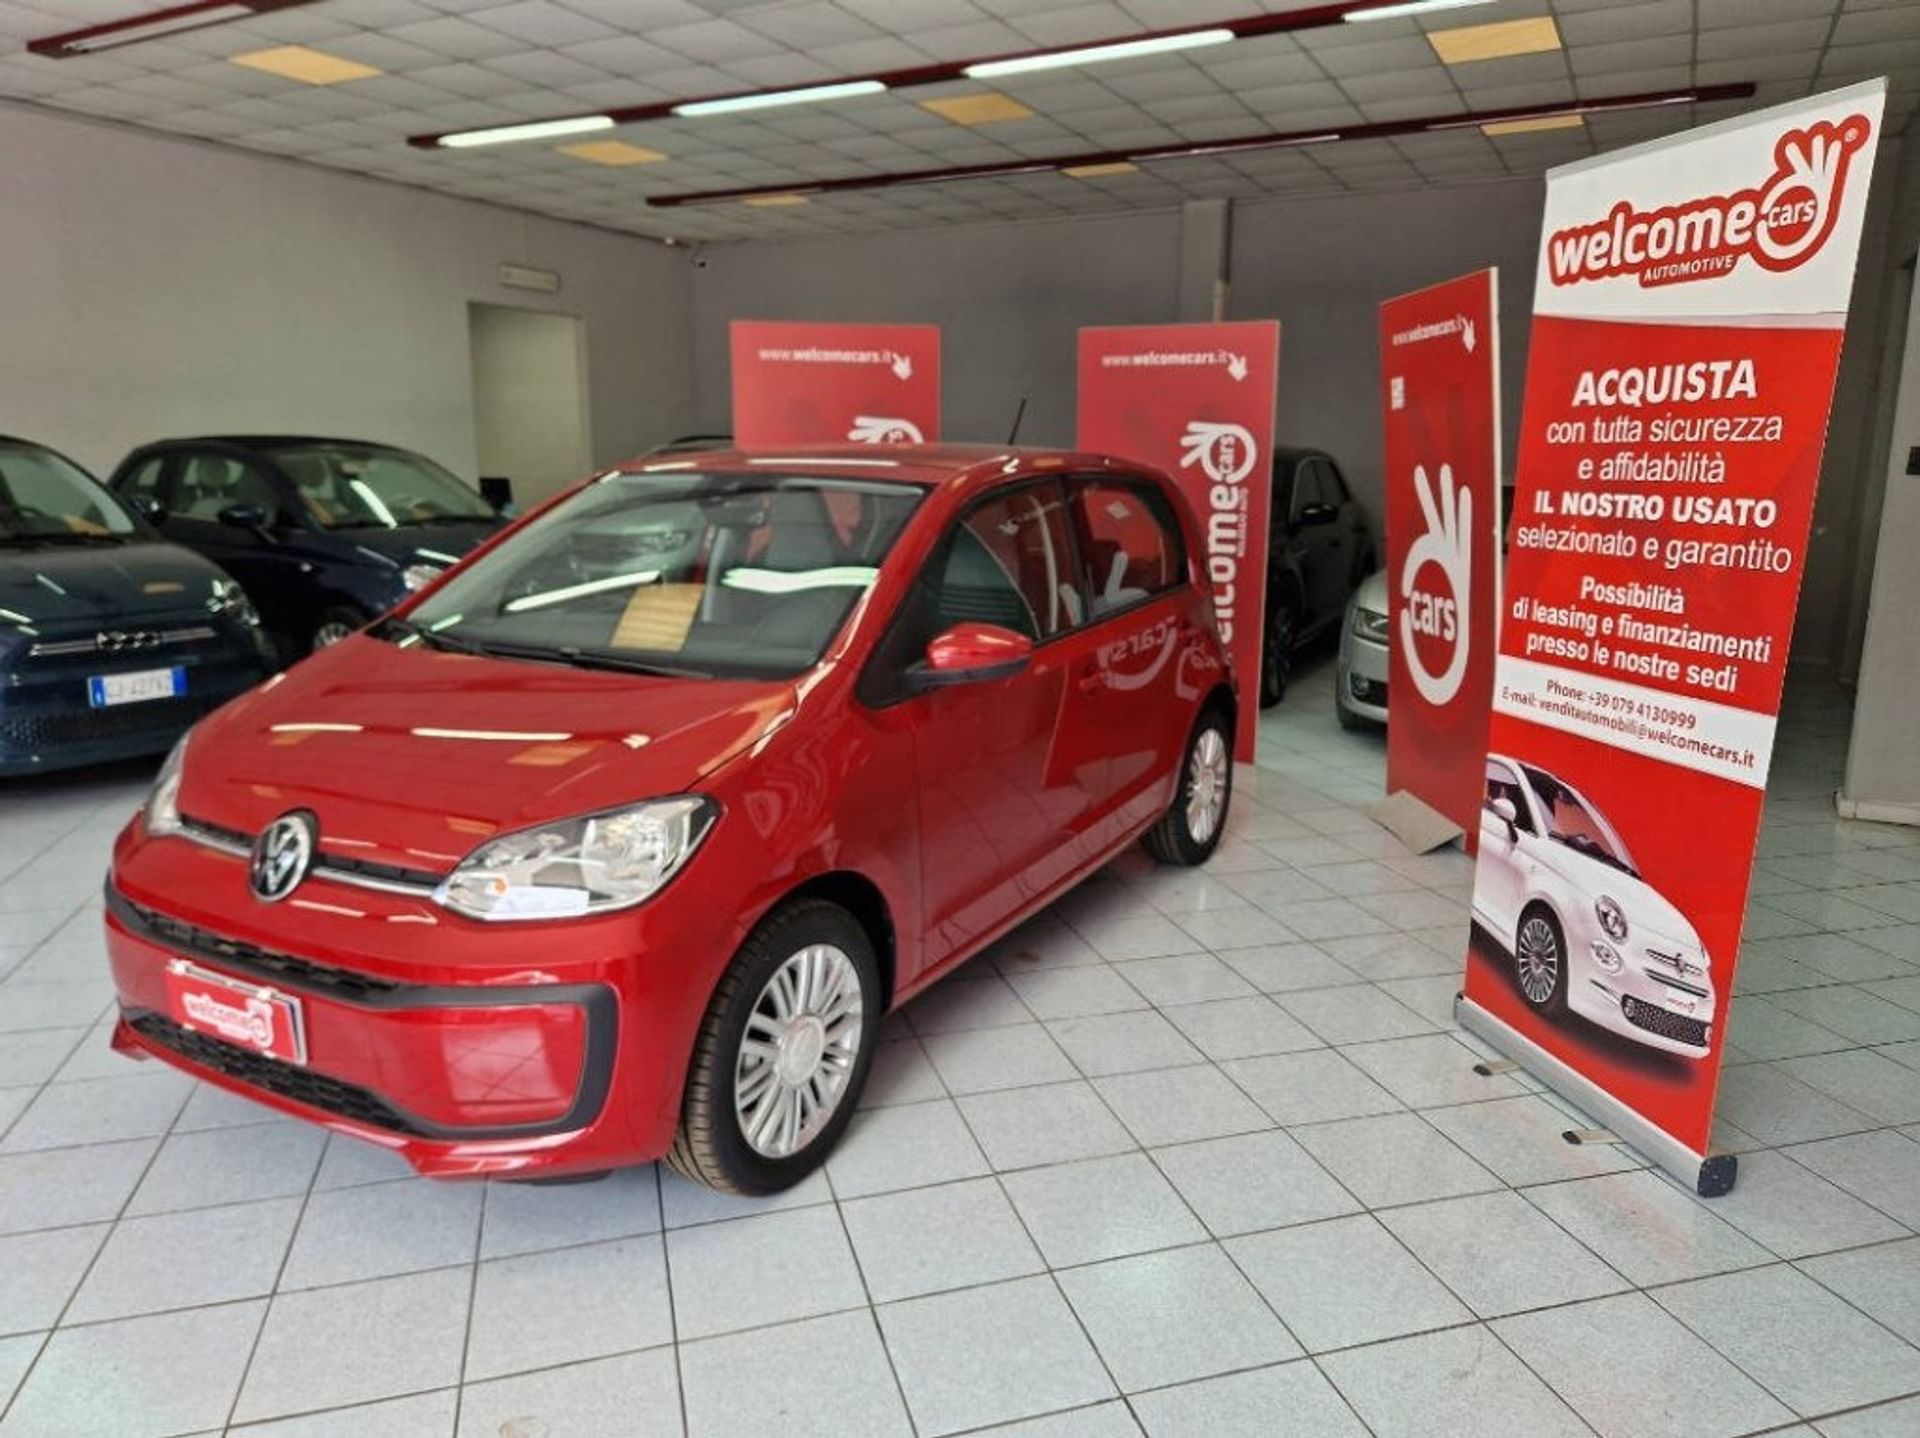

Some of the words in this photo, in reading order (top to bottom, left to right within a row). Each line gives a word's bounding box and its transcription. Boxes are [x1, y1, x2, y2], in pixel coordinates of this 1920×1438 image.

[1552, 198, 1756, 278] welcome
[1767, 198, 1818, 229] cars
[1643, 254, 1734, 282] AUTOMOTIVE
[1572, 359, 1758, 407] ACQUISTA
[1547, 419, 1585, 444] con
[1592, 414, 1642, 444] tutta
[1649, 412, 1783, 443] sicurezza
[1578, 457, 1593, 480] e
[1600, 451, 1727, 484] affidabilità
[1533, 490, 1554, 514] IL
[1561, 491, 1665, 521] NOSTRO
[1671, 496, 1777, 529] USATO
[1209, 484, 1239, 660] elcome
[1517, 523, 1638, 558] selezionato
[1643, 537, 1660, 560] e
[1664, 538, 1793, 574] garantito
[1410, 589, 1456, 642] cars
[1580, 575, 1686, 615] Possibilità
[1513, 597, 1528, 619] di
[1532, 599, 1598, 637] leasing
[1602, 616, 1613, 636] e
[1618, 614, 1773, 664] finanziamenti
[1526, 632, 1588, 662] presso
[1593, 642, 1610, 666] le
[1614, 648, 1680, 680] nostre
[1686, 662, 1738, 693] sedi
[1502, 686, 1539, 709] E-mail:
[1546, 678, 1586, 702] Phone:
[1588, 691, 1611, 709] +39
[1611, 695, 1635, 715] 079
[1636, 701, 1696, 730] 4130999
